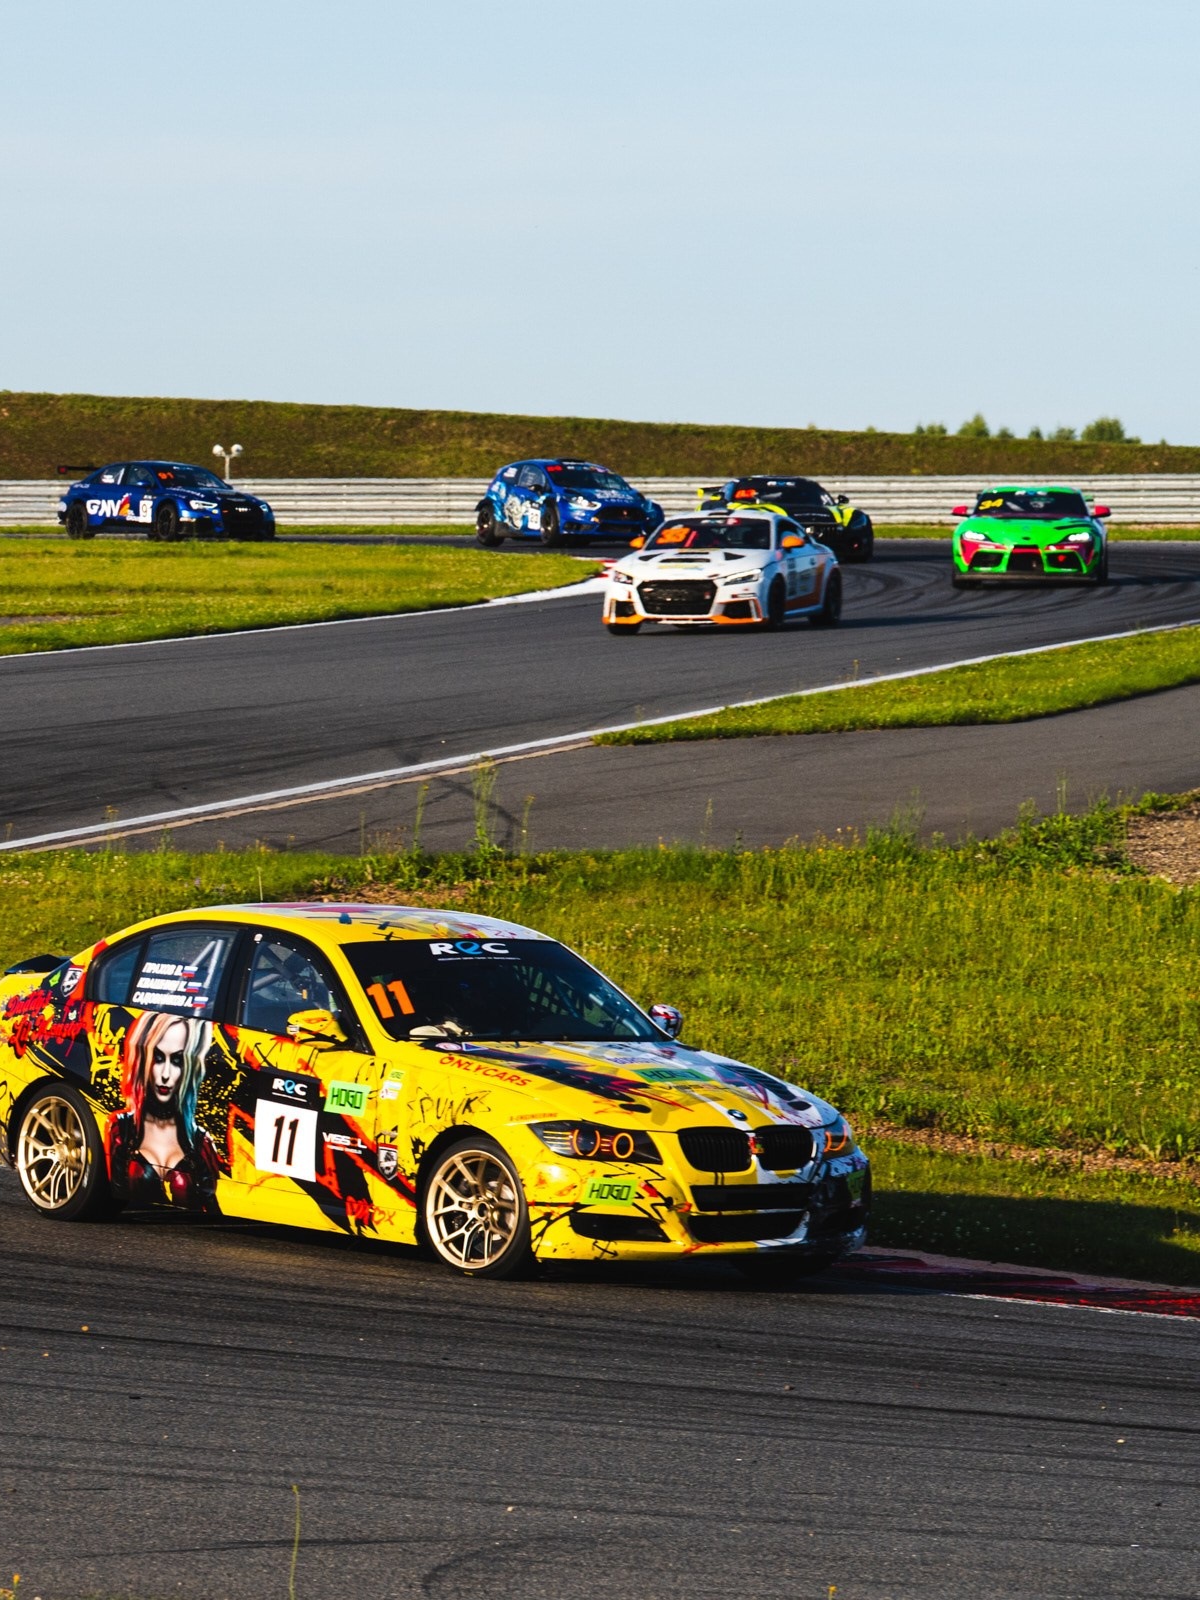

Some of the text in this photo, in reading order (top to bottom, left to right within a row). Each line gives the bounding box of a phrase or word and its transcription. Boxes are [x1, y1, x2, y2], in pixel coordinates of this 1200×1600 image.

[366, 979, 416, 1019] 11
[440, 1055, 532, 1087] ONLYCARS
[330, 1087, 363, 1110] HOGO
[271, 1115, 300, 1166] 11
[588, 1183, 632, 1201] HOGO
